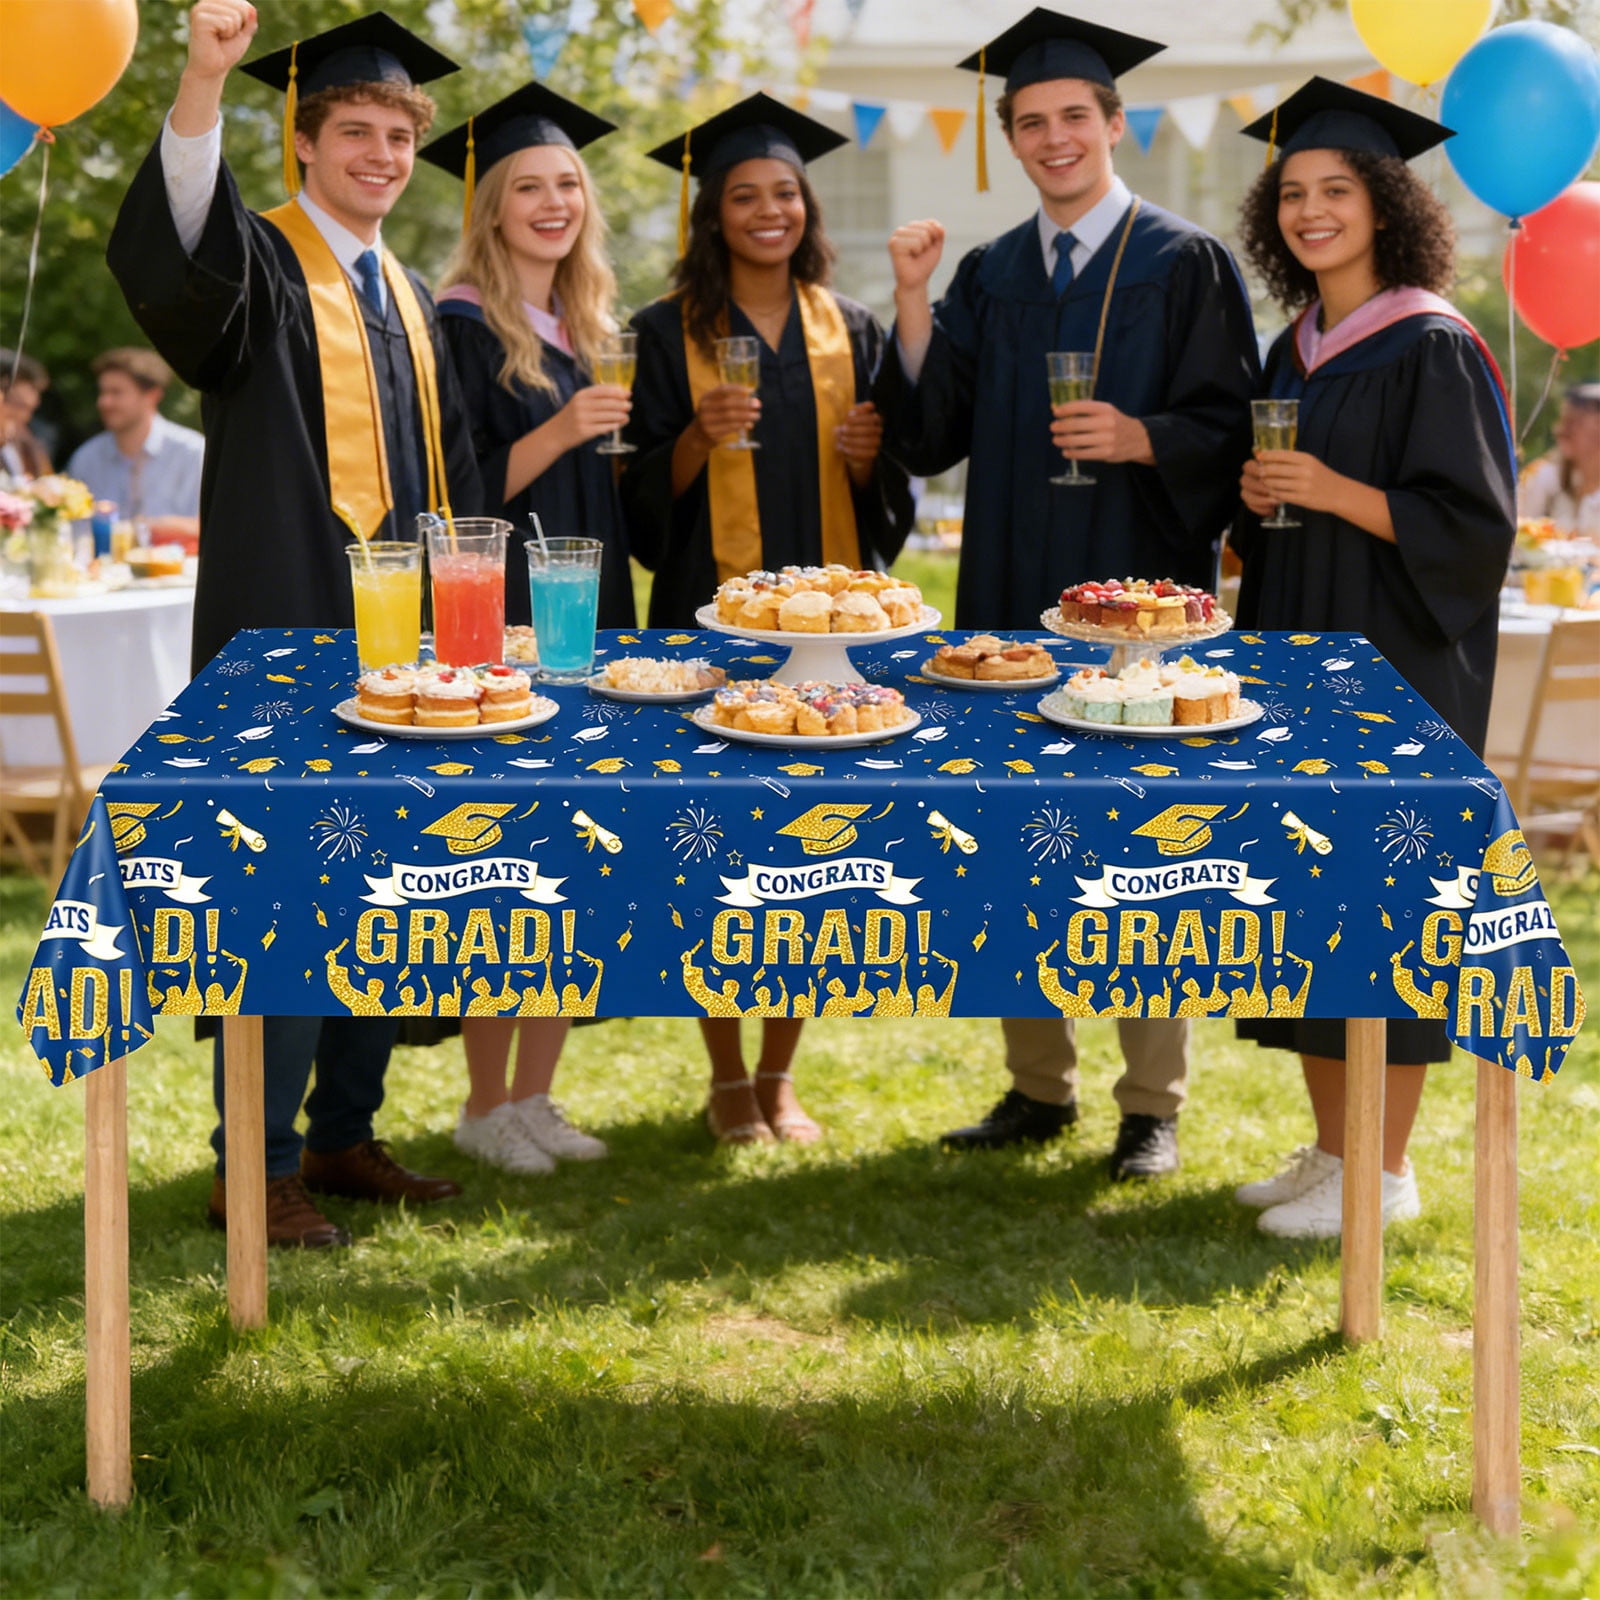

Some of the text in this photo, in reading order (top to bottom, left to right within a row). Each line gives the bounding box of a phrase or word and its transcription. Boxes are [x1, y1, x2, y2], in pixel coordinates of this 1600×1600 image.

[401, 862, 530, 893] CONGRATS
[756, 862, 885, 894] CONGRATS
[1111, 863, 1241, 894] CONGRATS
[129, 908, 220, 965] D!
[355, 908, 576, 965] GRAD!
[711, 908, 931, 965] GRAD!
[1066, 909, 1286, 966] GRAD!
